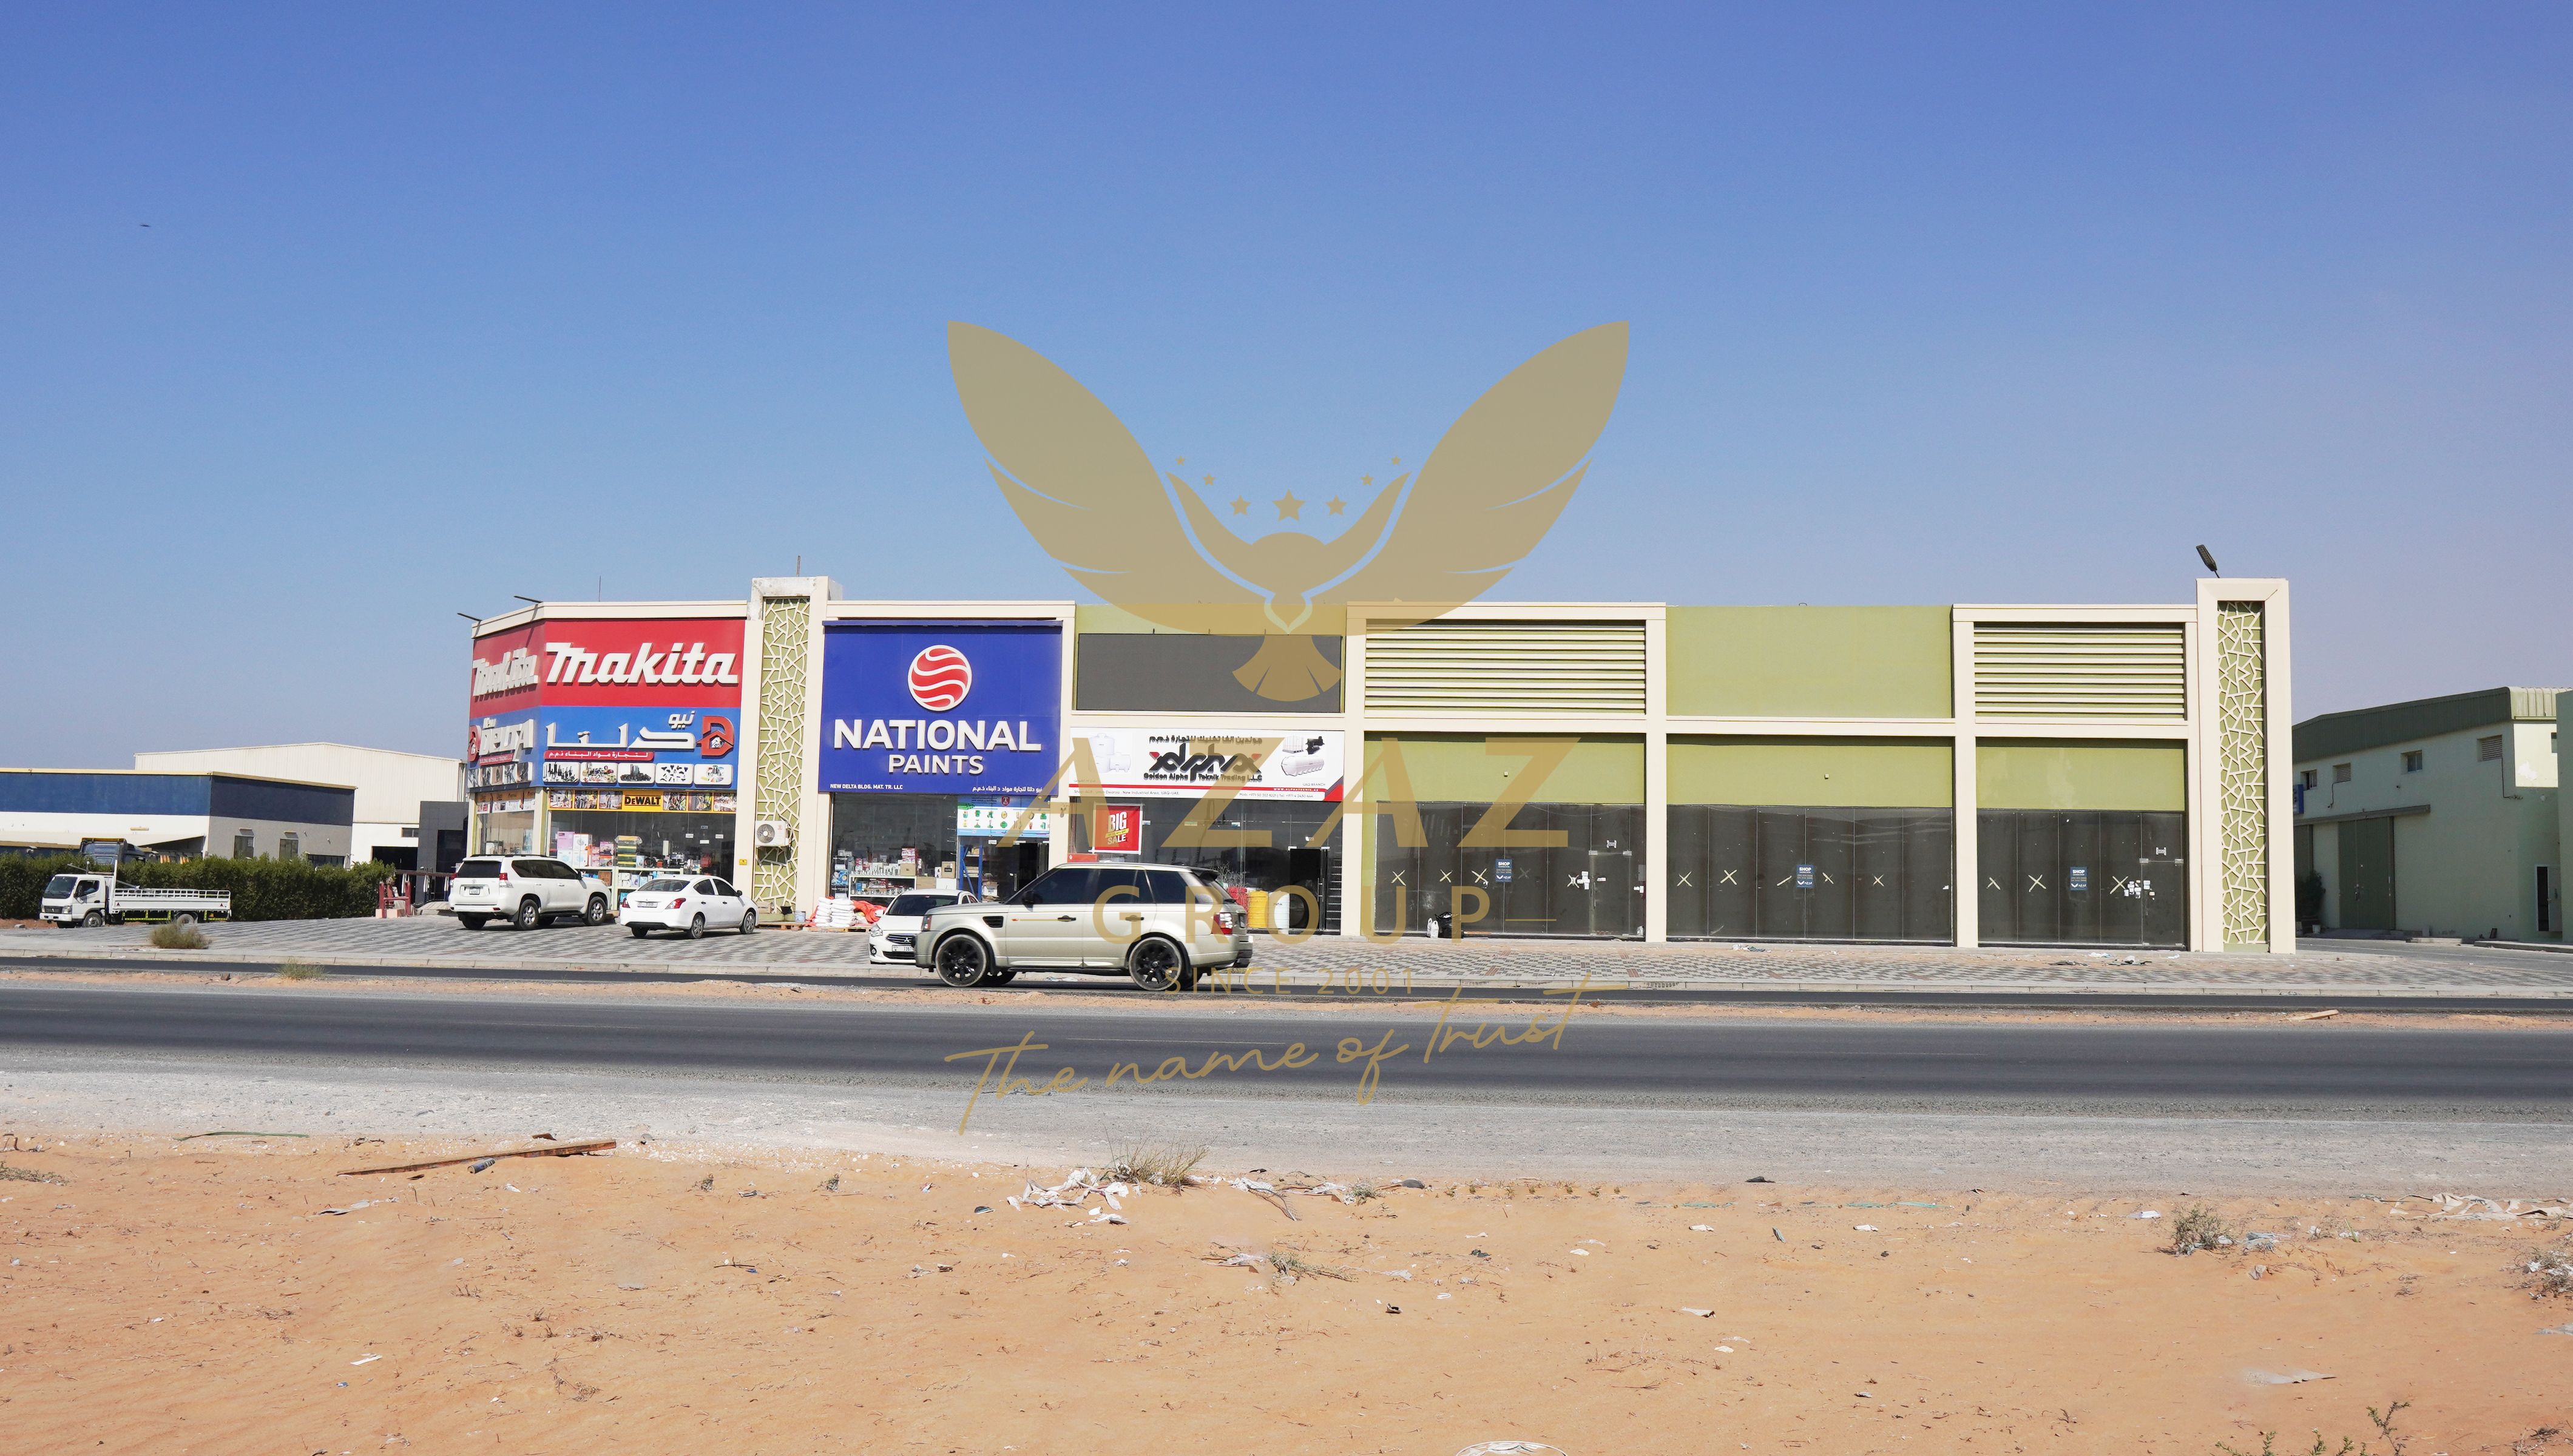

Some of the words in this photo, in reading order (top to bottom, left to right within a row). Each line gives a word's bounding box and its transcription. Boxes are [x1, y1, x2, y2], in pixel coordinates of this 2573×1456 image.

[834, 719, 1042, 752] NATIONAL
[888, 754, 984, 775] PAINTS
[1169, 773, 1188, 782] Alpha
[1220, 774, 1245, 783] Trading
[1107, 811, 1127, 832] BIG
[1107, 834, 1126, 844] SALE
